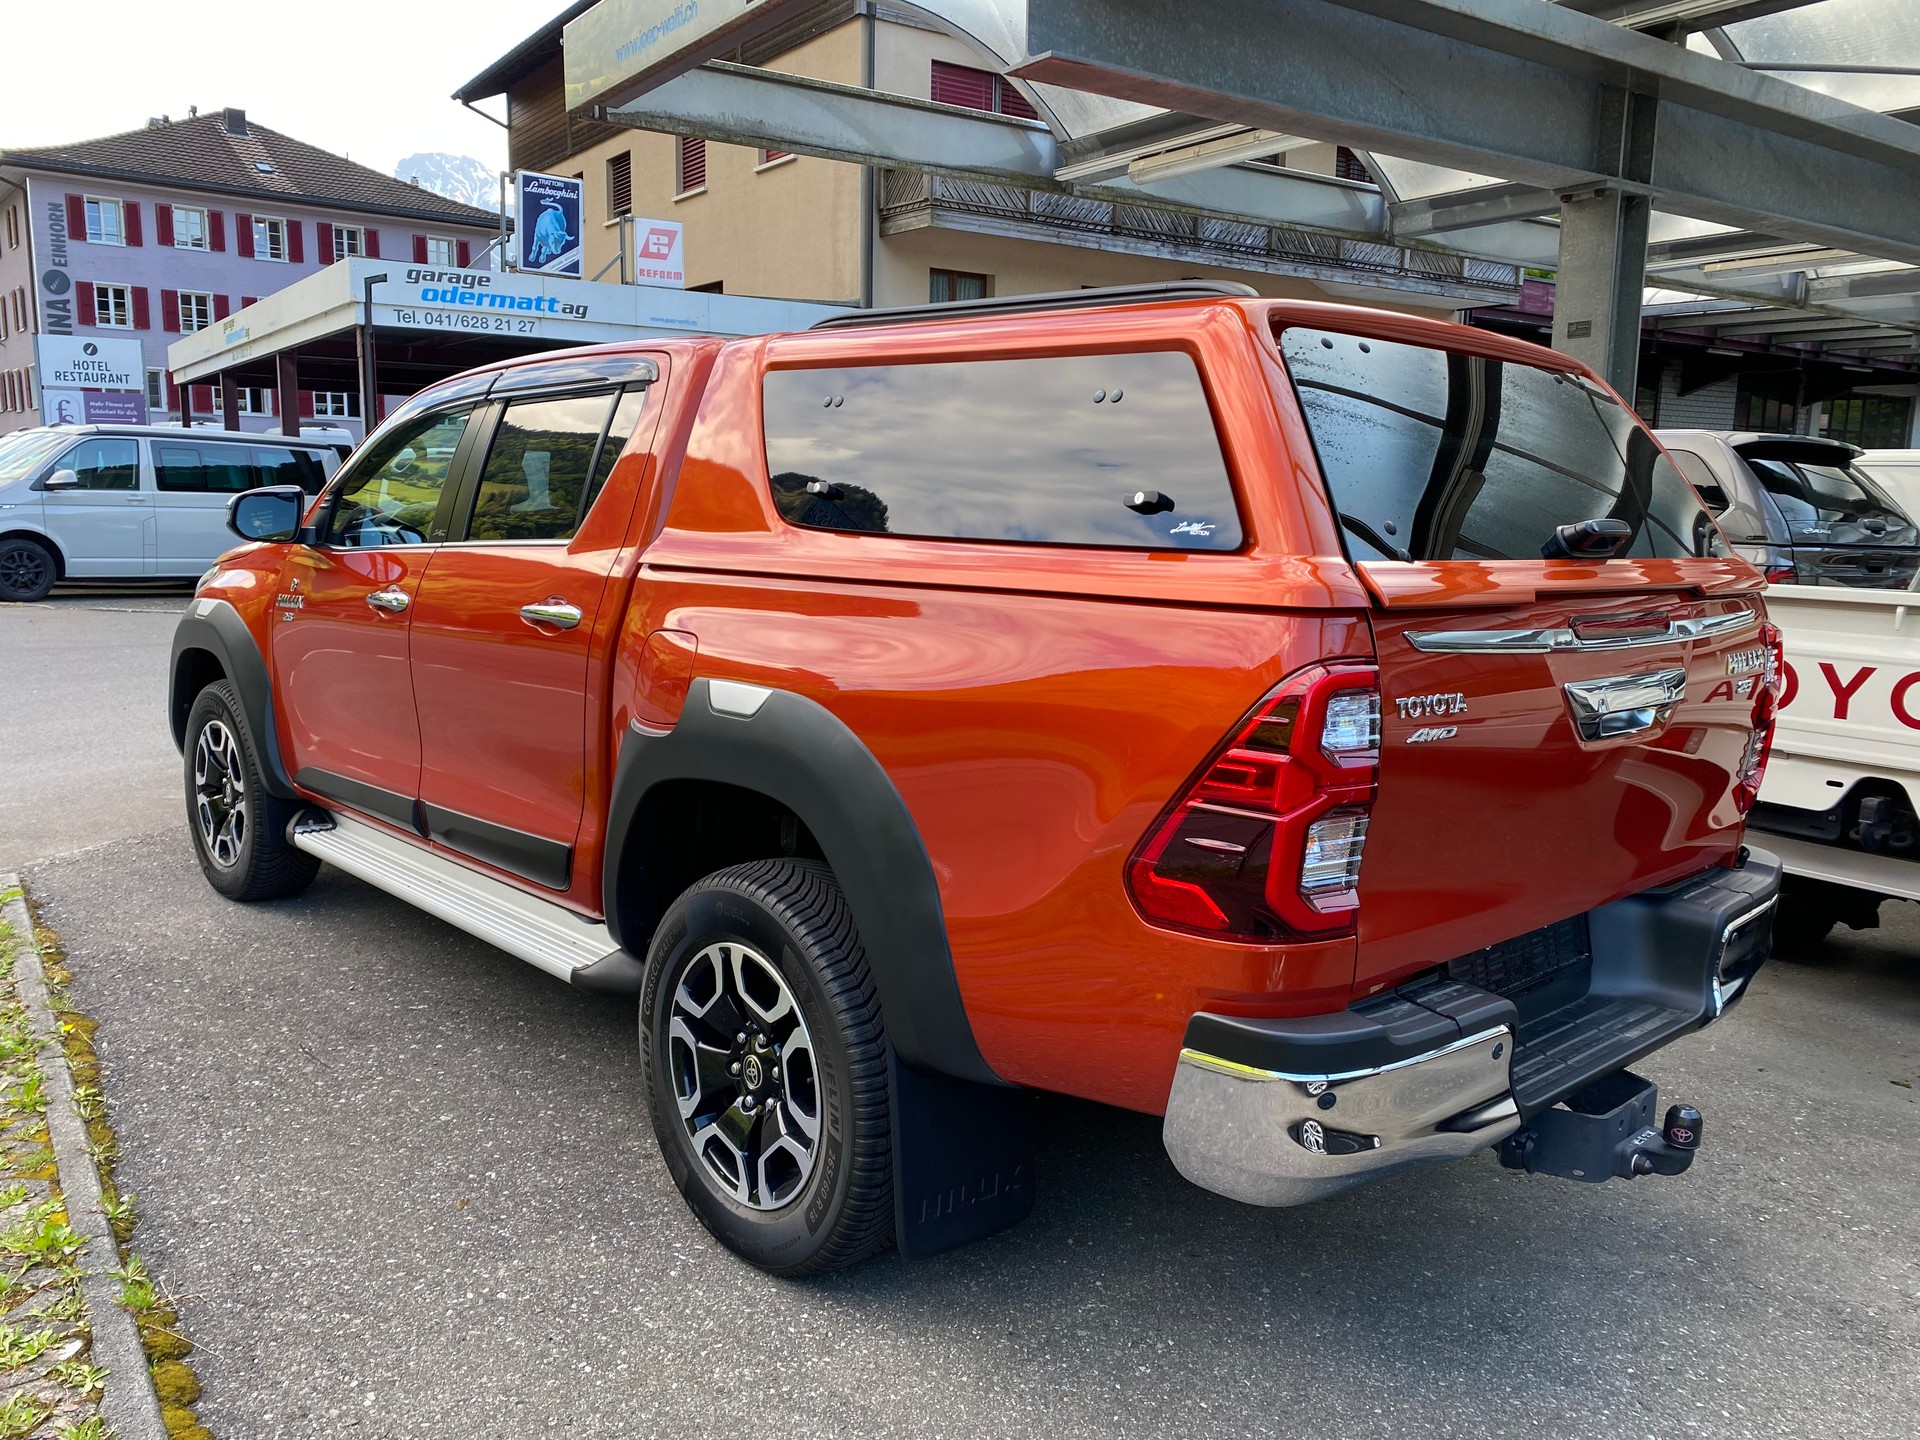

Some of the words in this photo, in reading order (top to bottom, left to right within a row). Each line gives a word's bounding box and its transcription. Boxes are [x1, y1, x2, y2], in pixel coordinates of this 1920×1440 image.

[523, 181, 579, 200] Lamborghini
[538, 178, 565, 188] TRATTORI
[47, 202, 68, 268] EINHORN
[405, 268, 491, 289] garage
[638, 268, 683, 281] REFORM
[420, 285, 560, 313] odermatt
[561, 300, 588, 319] ag
[393, 309, 420, 325] Tel.
[424, 311, 489, 330] 041/628
[494, 318, 512, 332] 21
[518, 320, 536, 334] 27
[72, 360, 111, 372] HOTEL
[54, 370, 130, 385] RESTAURANT
[1395, 692, 1468, 719] TOYOTA
[820, 1147, 836, 1199] 265/60
[815, 1198, 824, 1211] R
